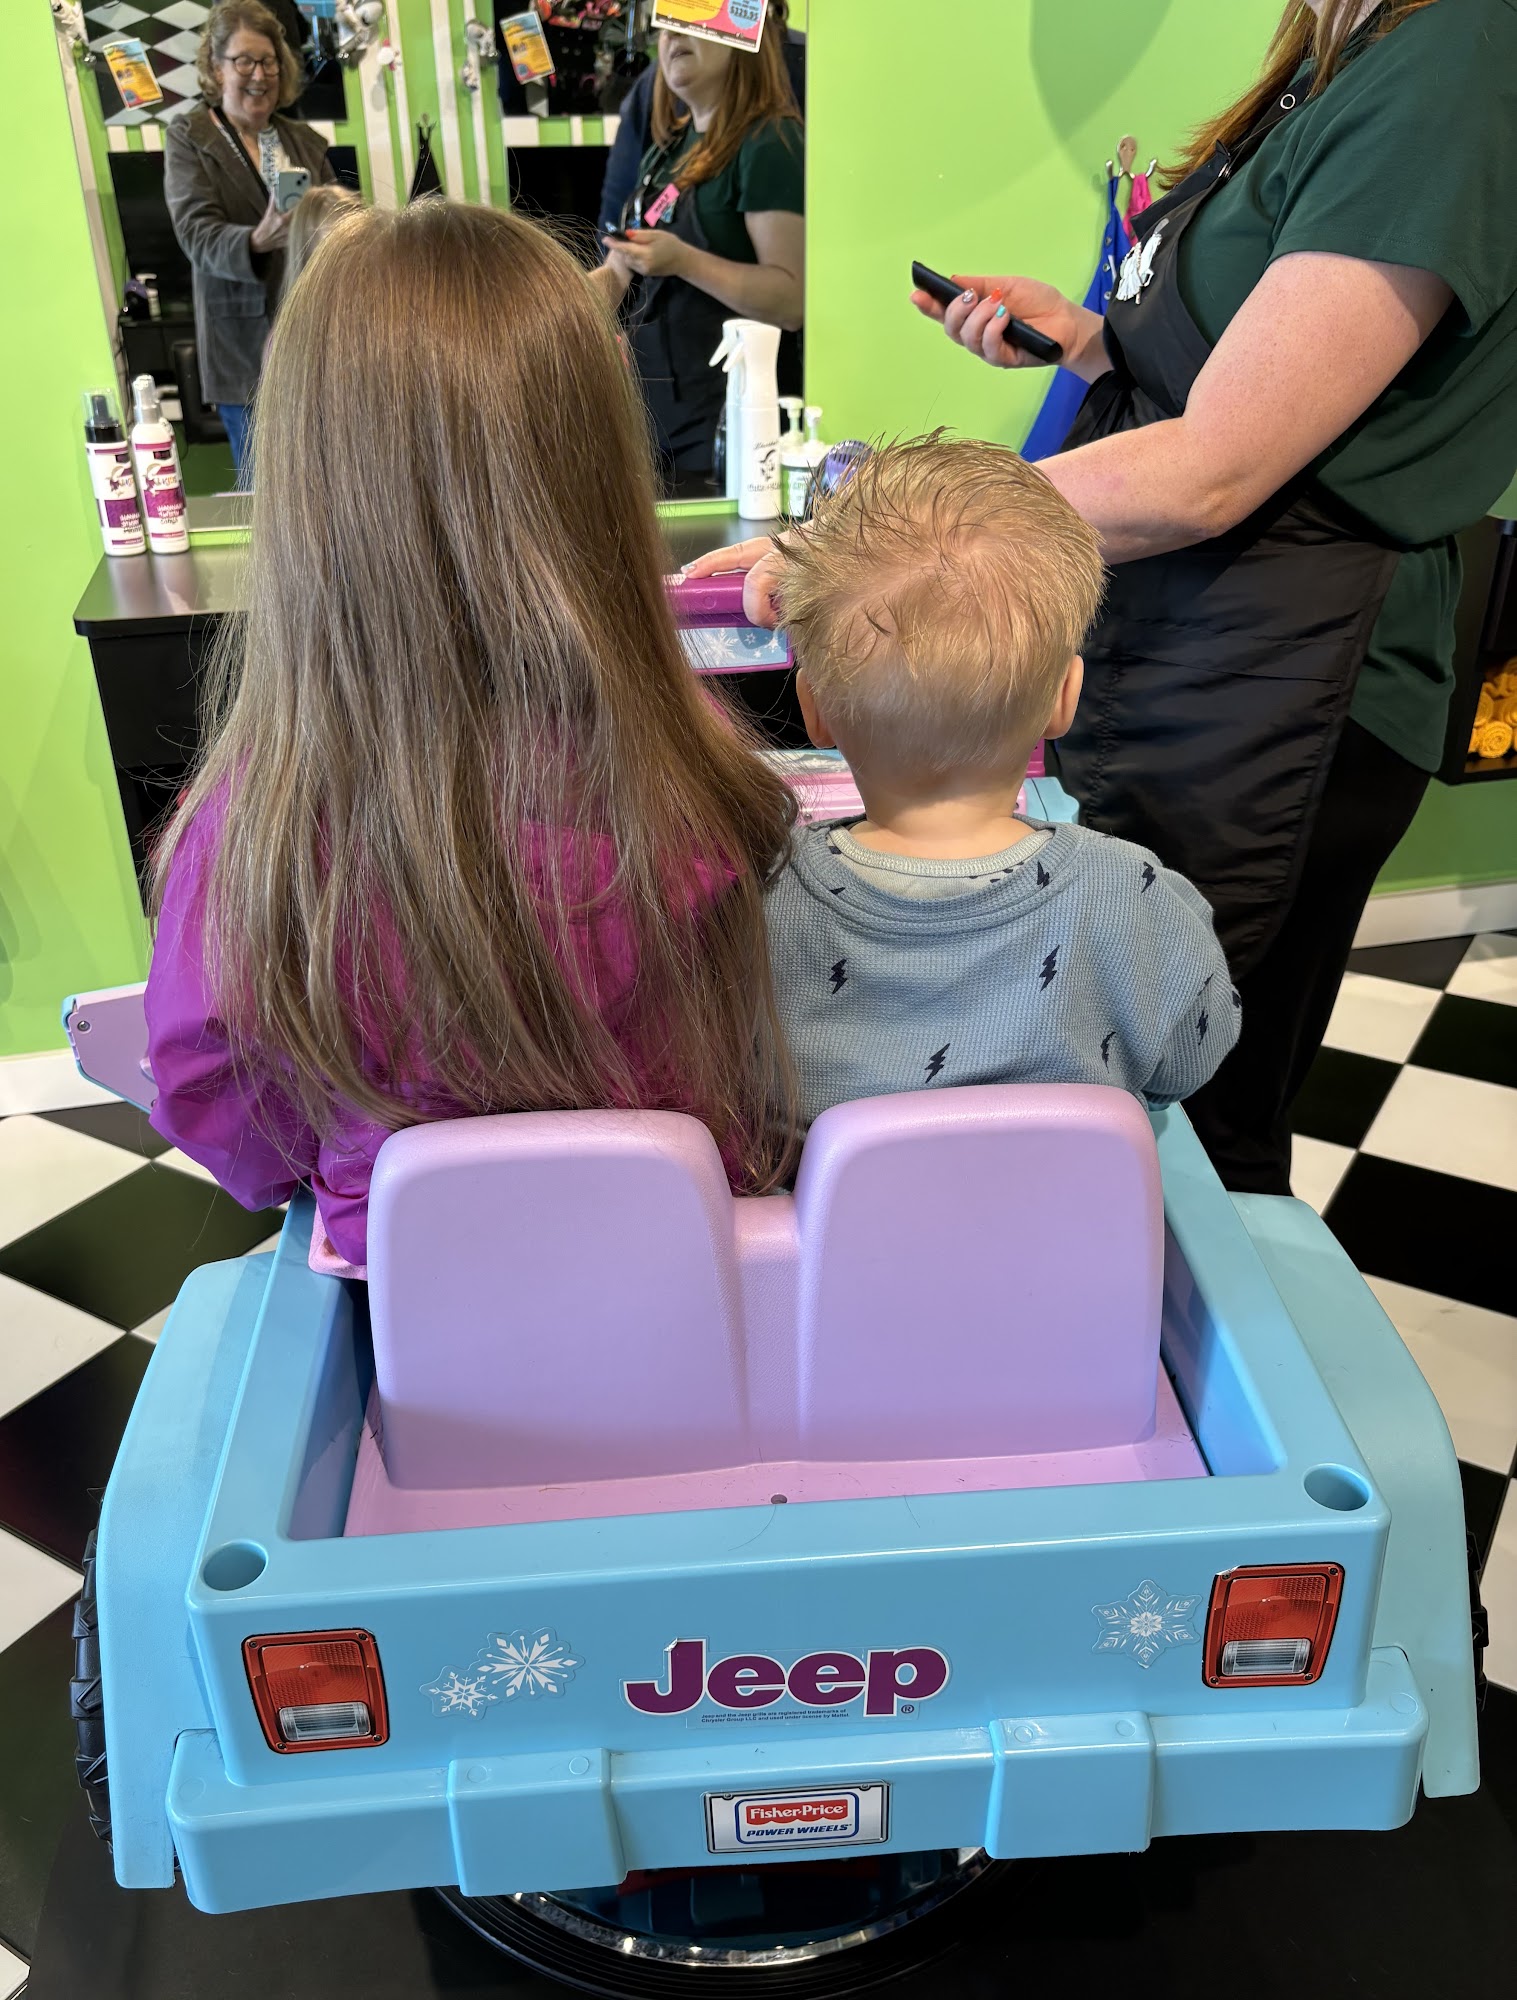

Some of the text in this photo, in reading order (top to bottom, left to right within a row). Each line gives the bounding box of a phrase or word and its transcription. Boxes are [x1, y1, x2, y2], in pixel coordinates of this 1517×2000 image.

[623, 1637, 950, 1718] Jeep
[750, 1804, 845, 1820] Fisher-Price
[746, 1827, 794, 1837] POWER
